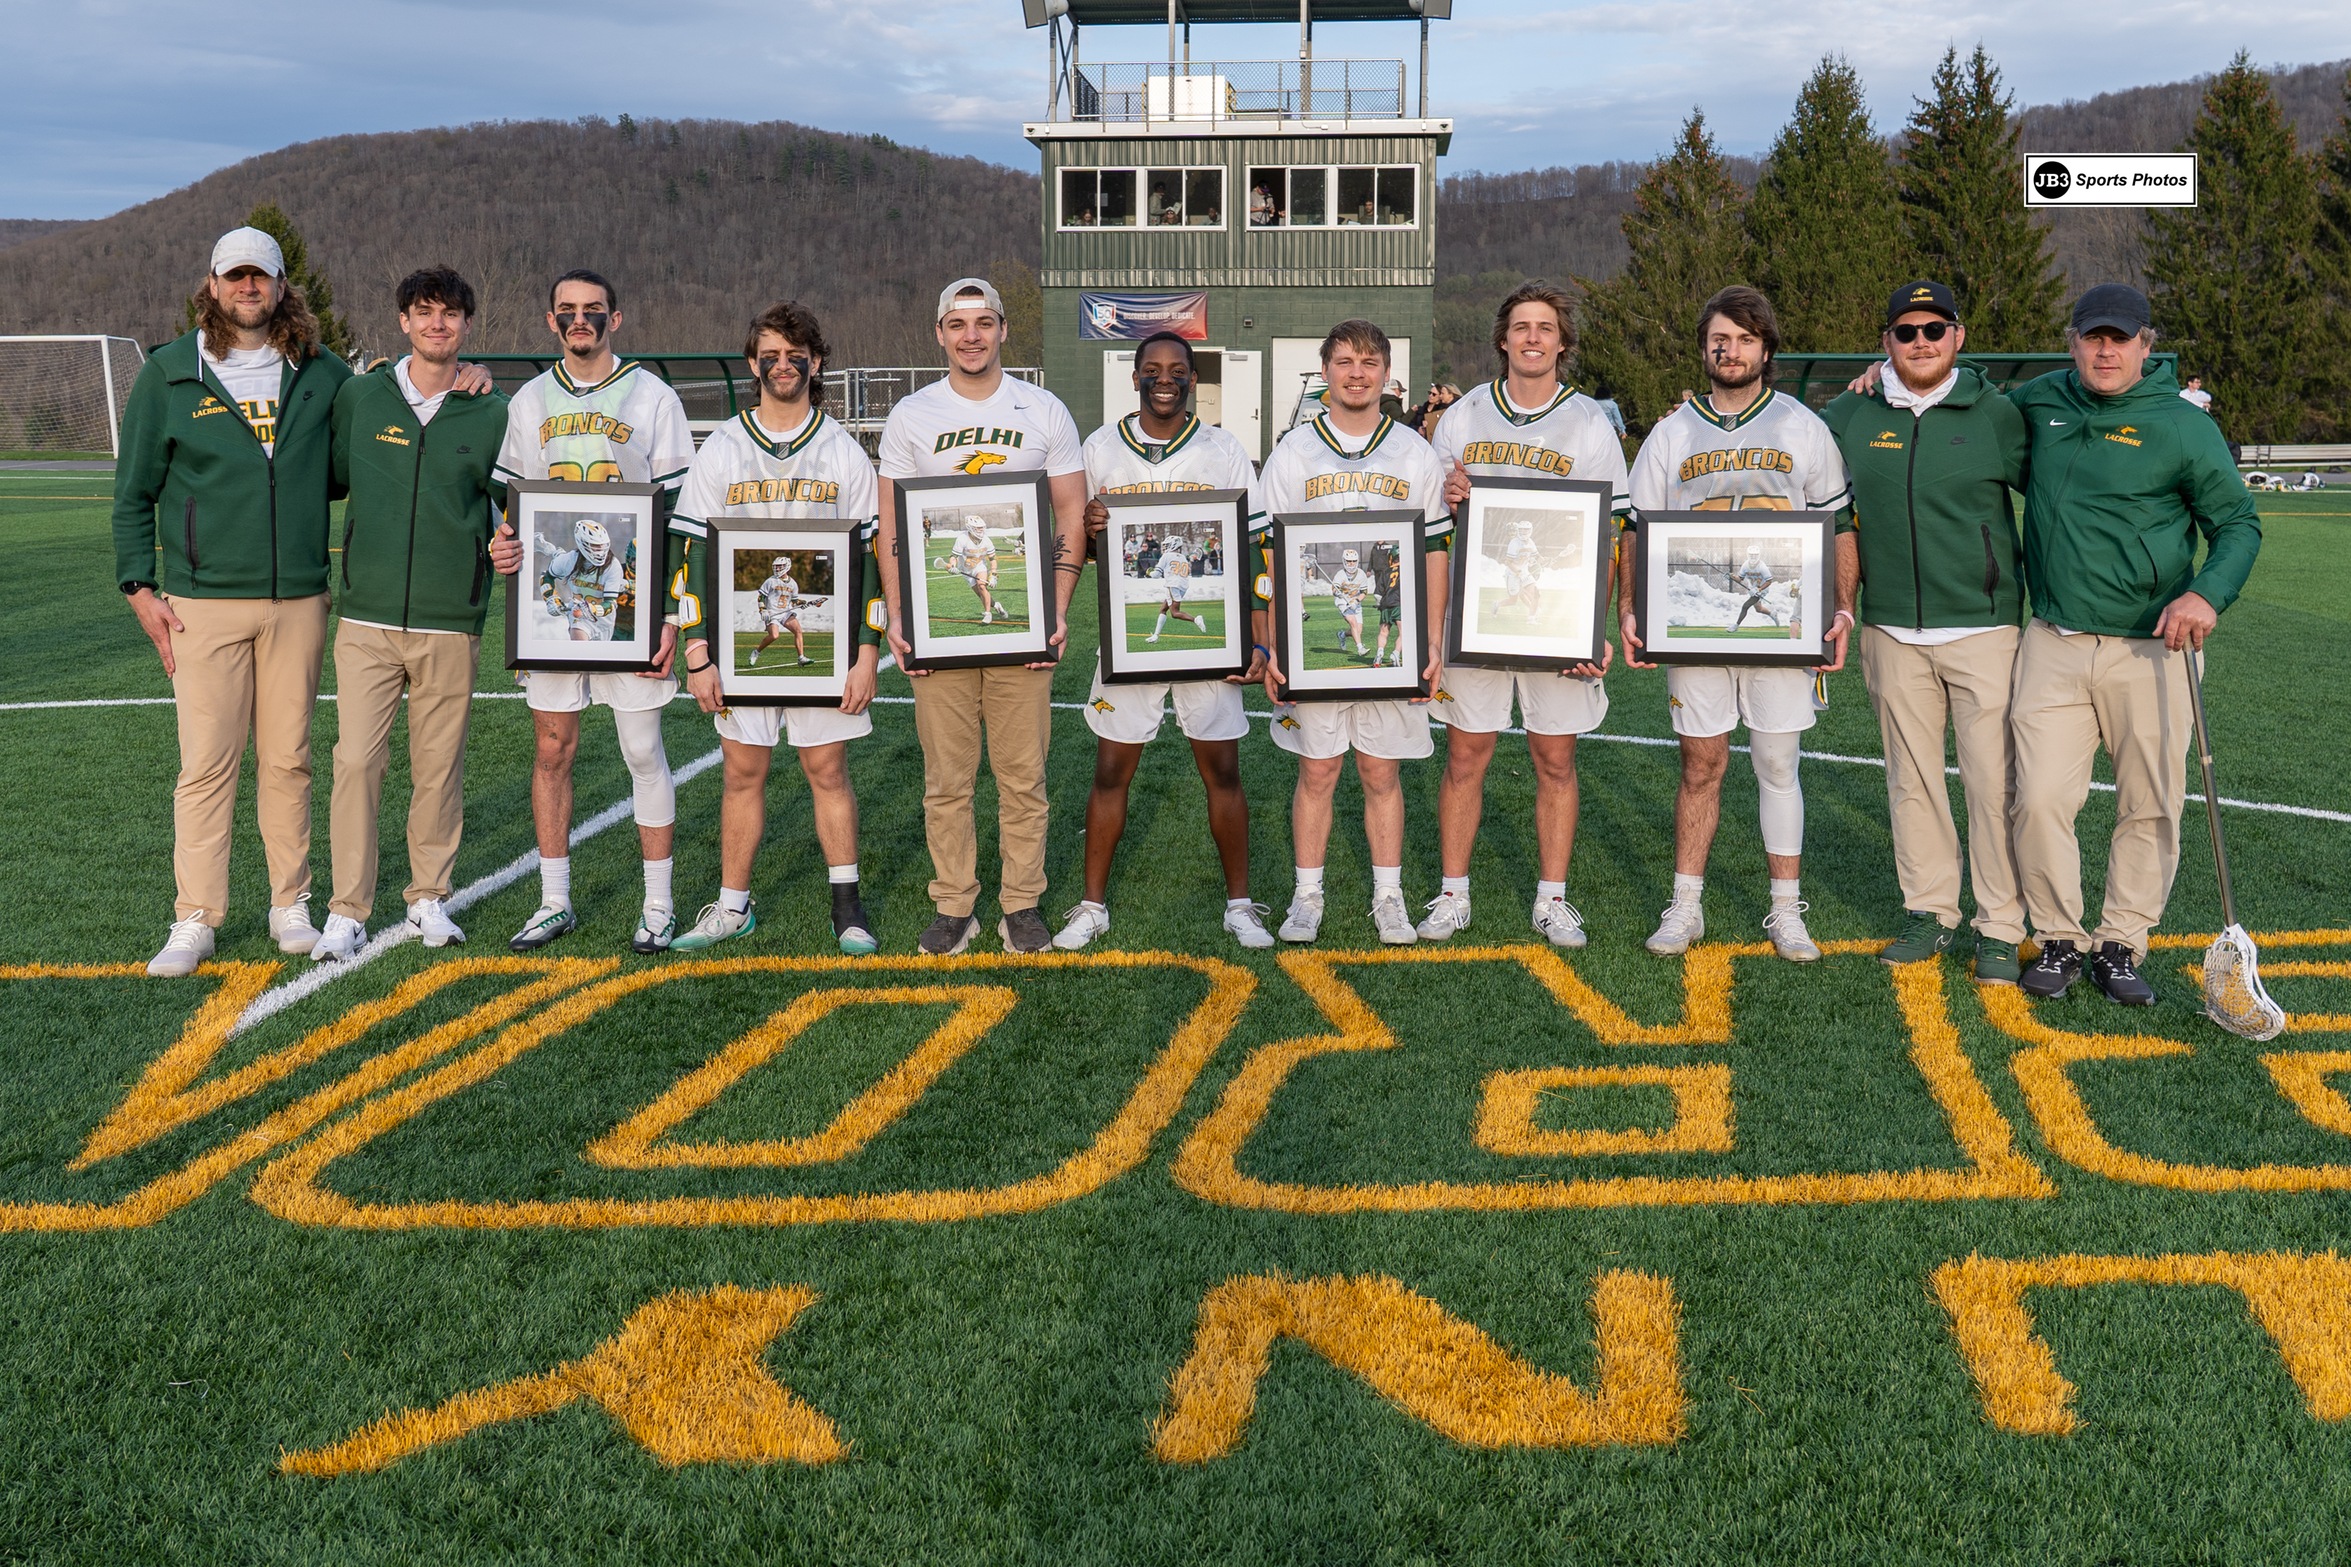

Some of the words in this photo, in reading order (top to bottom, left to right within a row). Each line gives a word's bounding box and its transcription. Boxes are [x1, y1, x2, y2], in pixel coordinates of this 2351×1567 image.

[192, 405, 229, 419] LACROSS
[375, 433, 411, 447] LACROSSE
[933, 426, 1024, 455] DELHI
[1869, 440, 1904, 449] LACROSSE
[2104, 433, 2143, 448] LACROSSE
[1463, 441, 1575, 477] BRONCOS
[1678, 447, 1794, 483] BRONCOS
[725, 477, 840, 506] BRONCOS
[1305, 471, 1411, 503] BRONCOS
[1540, 917, 1551, 929] N
